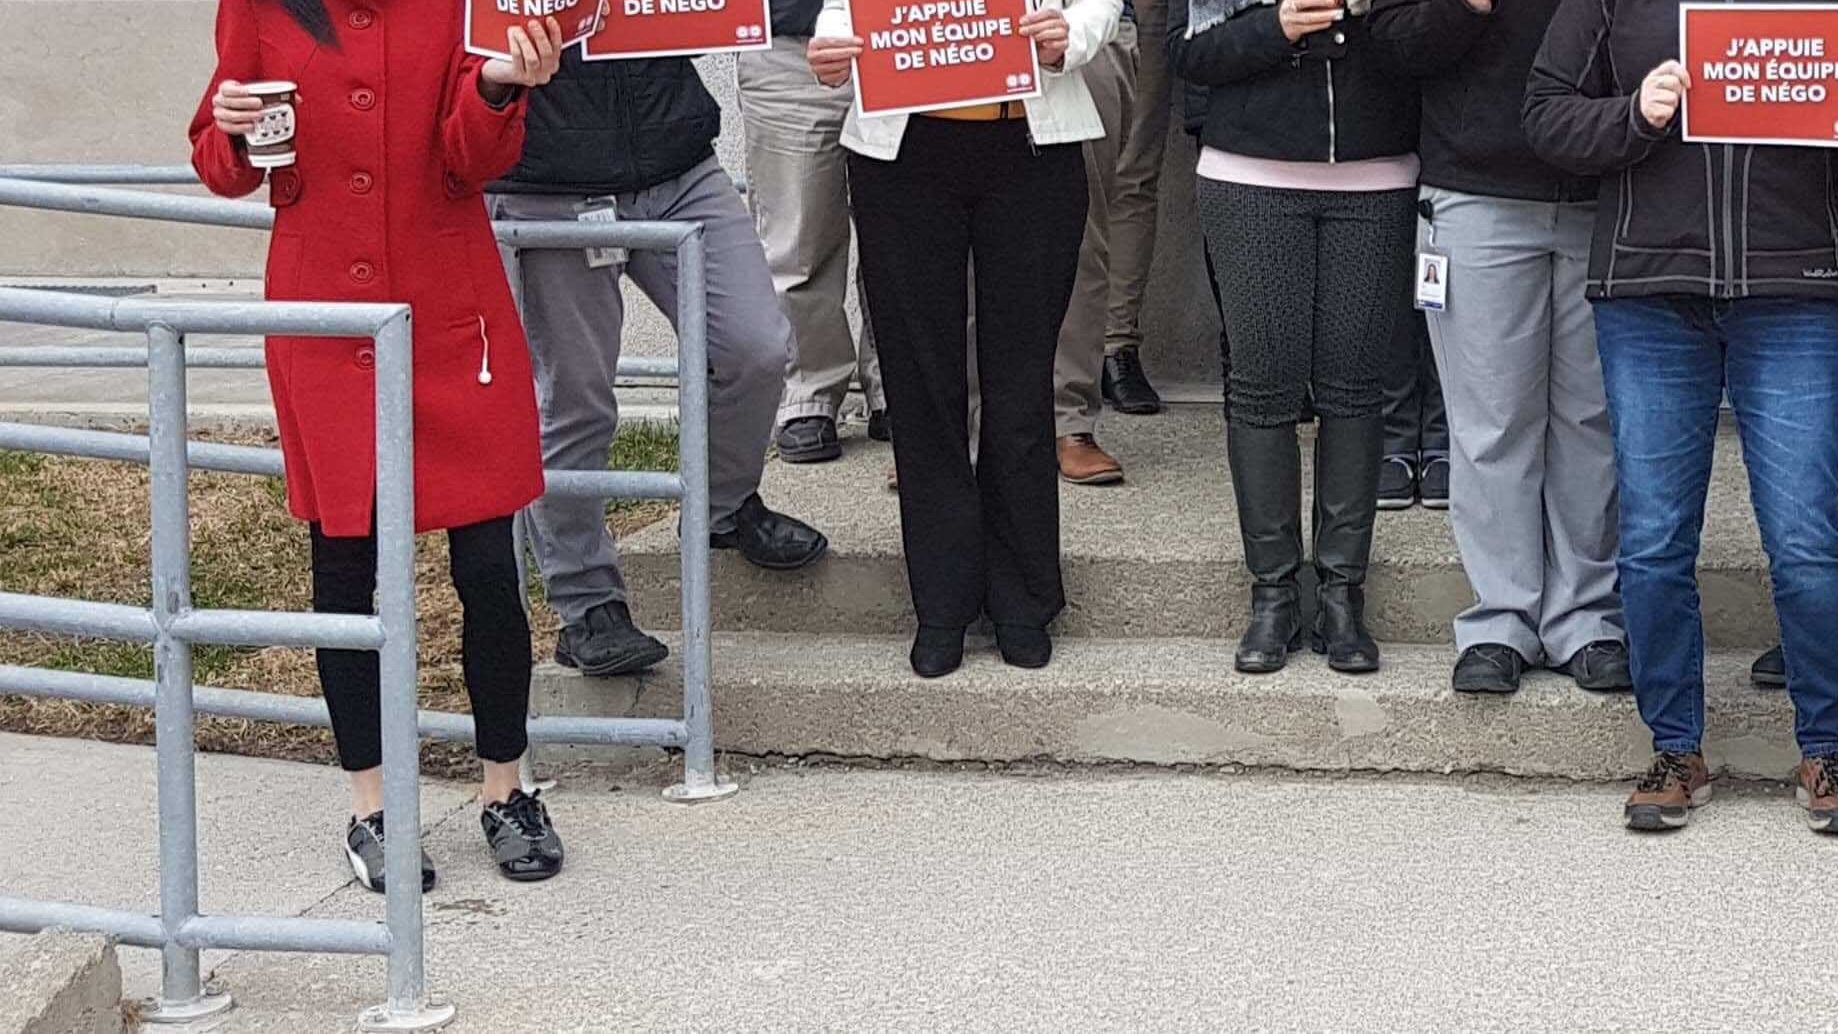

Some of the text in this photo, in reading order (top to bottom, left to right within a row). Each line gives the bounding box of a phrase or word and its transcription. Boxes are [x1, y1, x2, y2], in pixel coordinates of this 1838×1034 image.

[870, 18, 1012, 50] MON ÉQUIPE
[894, 42, 994, 70] DE NÉGO
[1726, 38, 1825, 57] J'APPUIE
[1703, 62, 1760, 80] MON
[1725, 81, 1826, 102] DE NÉGO
